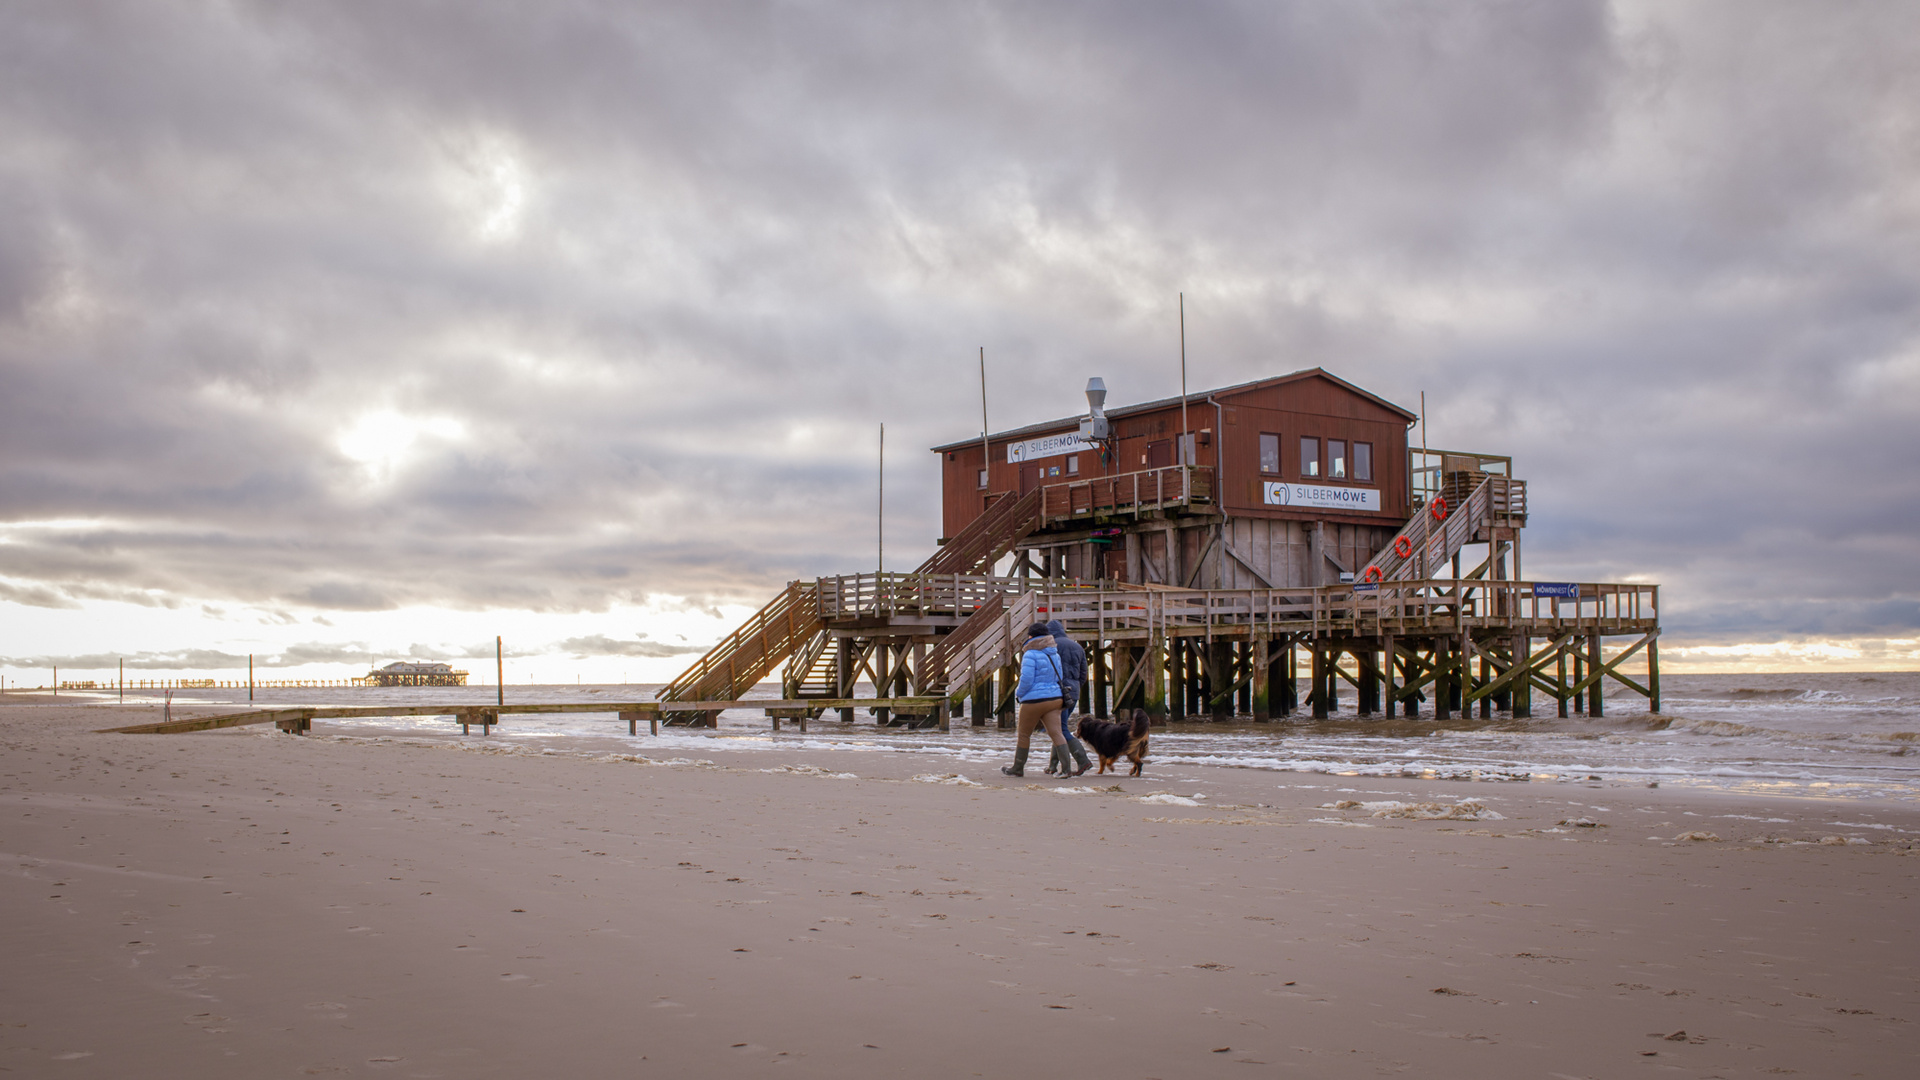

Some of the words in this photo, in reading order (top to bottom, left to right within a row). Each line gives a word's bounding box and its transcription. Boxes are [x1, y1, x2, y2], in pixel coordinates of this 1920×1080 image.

[1031, 434, 1080, 452] SILBERMÖW
[1297, 488, 1366, 503] SILBERMÖWE
[1536, 585, 1567, 594] MÖWENNEST
